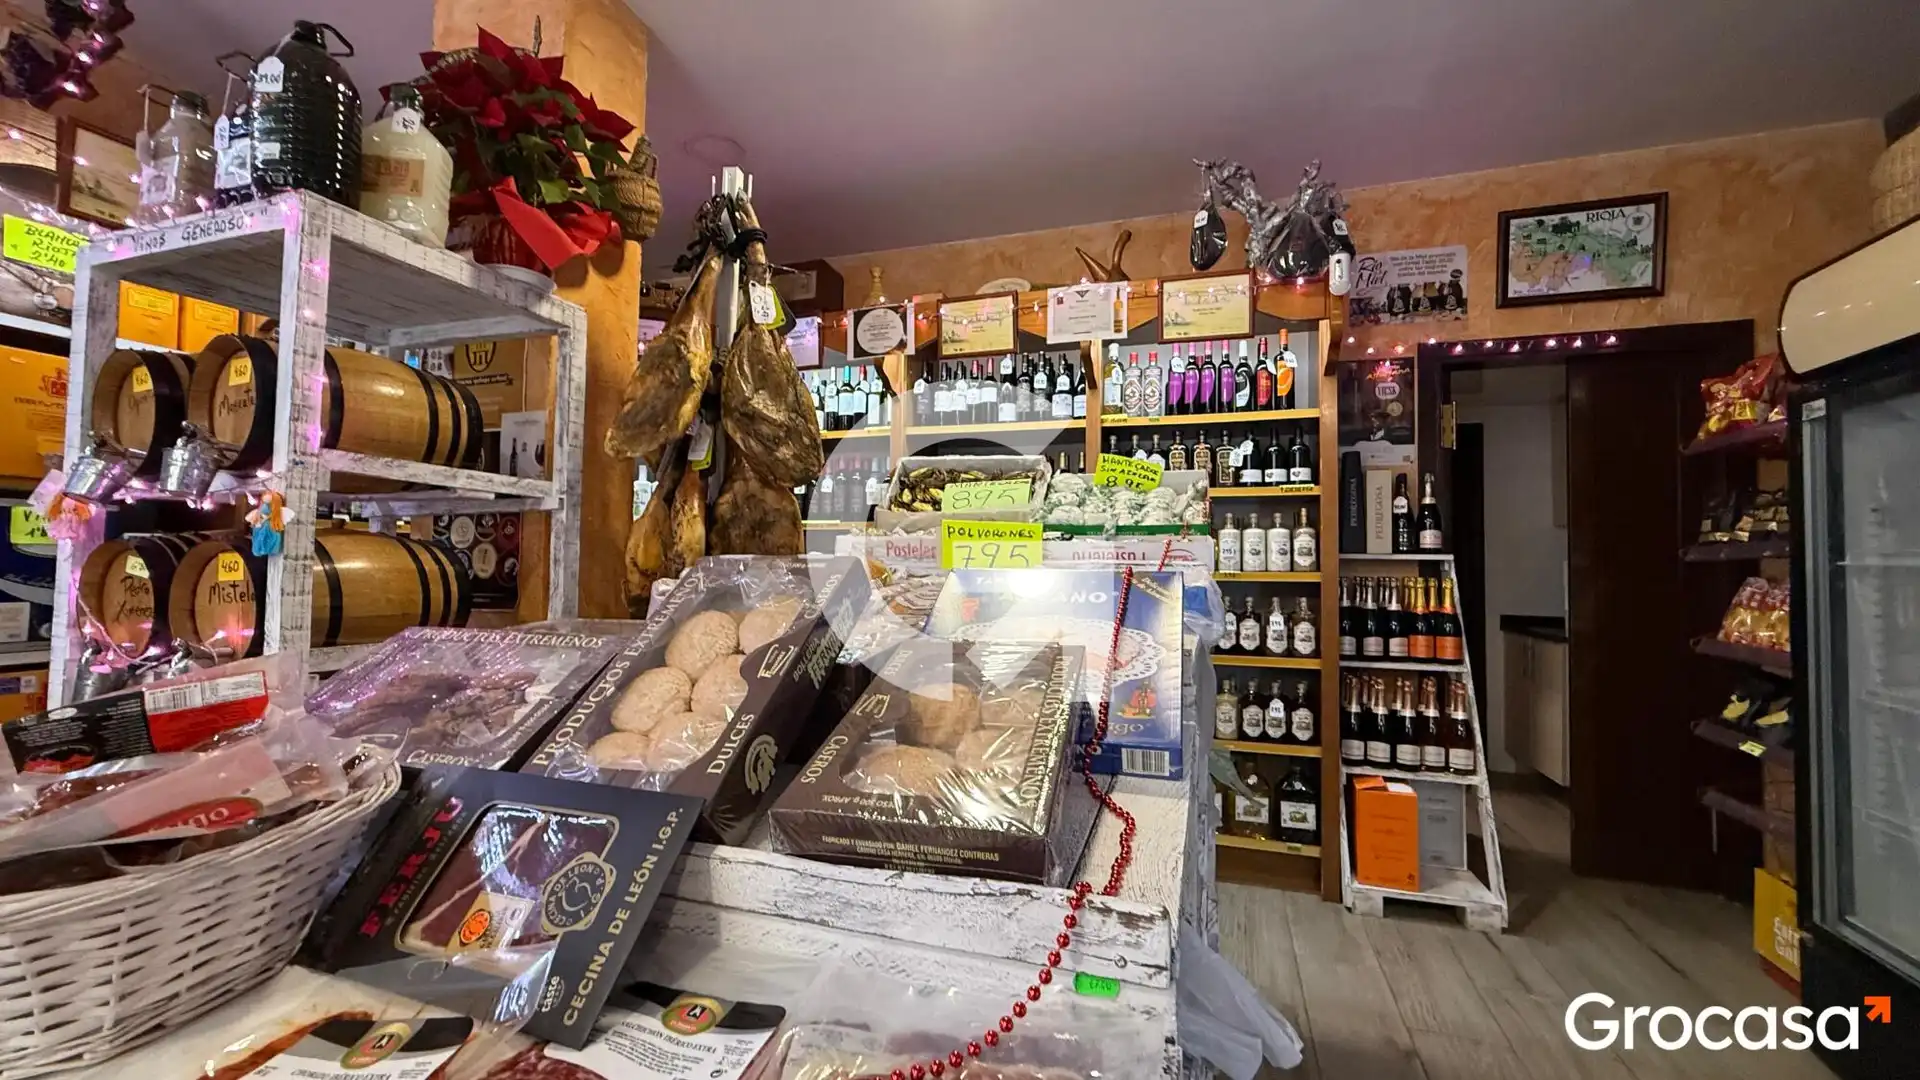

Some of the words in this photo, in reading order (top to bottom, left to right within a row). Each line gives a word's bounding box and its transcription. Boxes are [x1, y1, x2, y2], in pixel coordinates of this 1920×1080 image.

[1586, 208, 1626, 223] RIOJA
[946, 525, 1034, 539] POLVORONES
[221, 560, 239, 573] 460
[532, 660, 630, 767] PRODUCTOS
[706, 712, 755, 775] DULCES
[801, 735, 849, 785] CASEROS
[959, 850, 1000, 862] CONTRERAS
[563, 941, 615, 1027] CECINA
[608, 907, 629, 936] DE
[624, 854, 659, 903] LEÓN
[652, 808, 684, 850] I.G.P.
